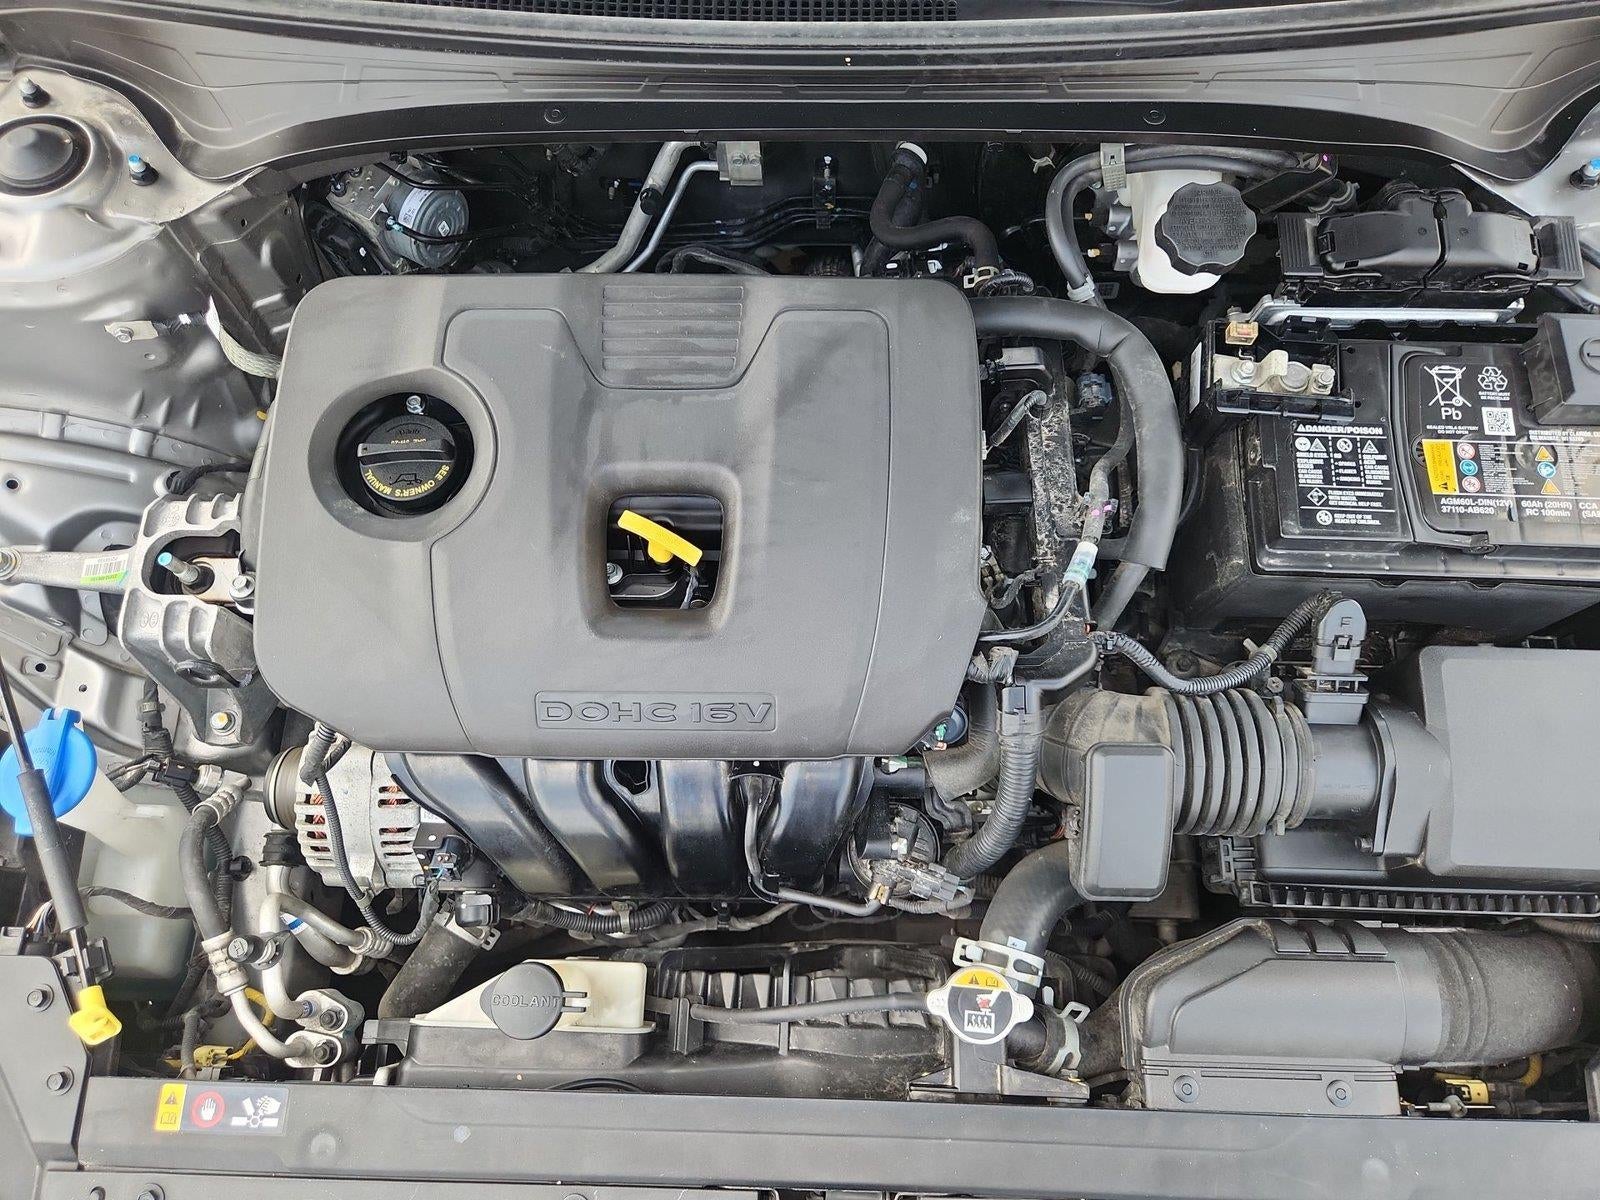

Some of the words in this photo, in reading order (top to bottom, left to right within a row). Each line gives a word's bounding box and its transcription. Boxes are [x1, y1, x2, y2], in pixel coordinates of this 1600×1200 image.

[1441, 407, 1462, 421] Pb
[1305, 424, 1384, 435] DANGER/POISON
[434, 464, 450, 480] SEE
[364, 468, 392, 496] MANUAL
[395, 479, 436, 497] OWNER'S
[1440, 497, 1513, 508] AGM60L-DIN(12V)
[1521, 500, 1543, 508] 60Ah
[1545, 501, 1573, 510] (20HR)
[1441, 505, 1495, 514] 37110-AB620
[1526, 508, 1539, 516] RC
[1541, 509, 1570, 517] 100min
[1340, 616, 1353, 628] F
[540, 700, 677, 723] DOHC
[690, 701, 772, 724] 16V
[492, 993, 562, 1009] COOLANT
